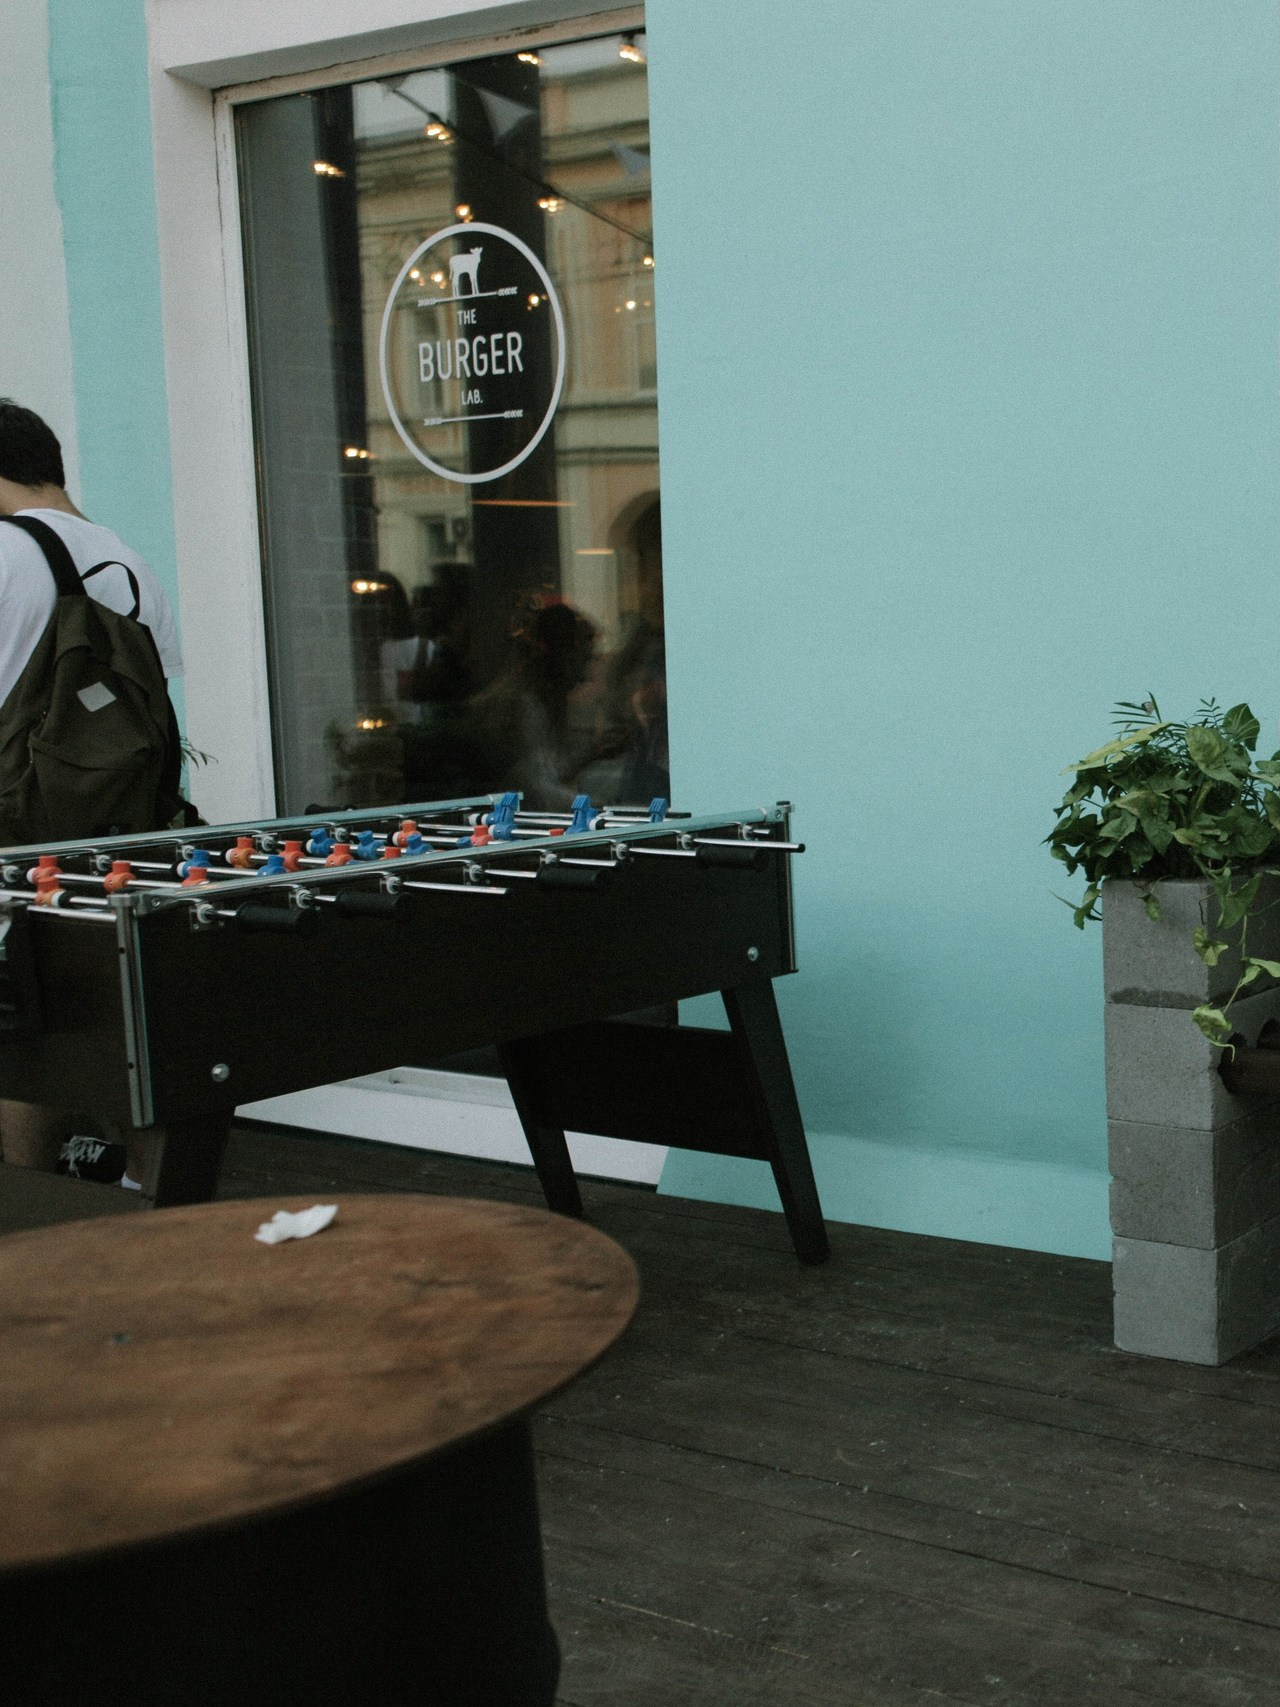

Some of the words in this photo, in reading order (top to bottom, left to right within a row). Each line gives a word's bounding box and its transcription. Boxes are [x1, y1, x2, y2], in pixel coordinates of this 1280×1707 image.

[457, 308, 477, 325] THE
[418, 331, 523, 382] BURGER
[461, 389, 483, 406] LAB.
